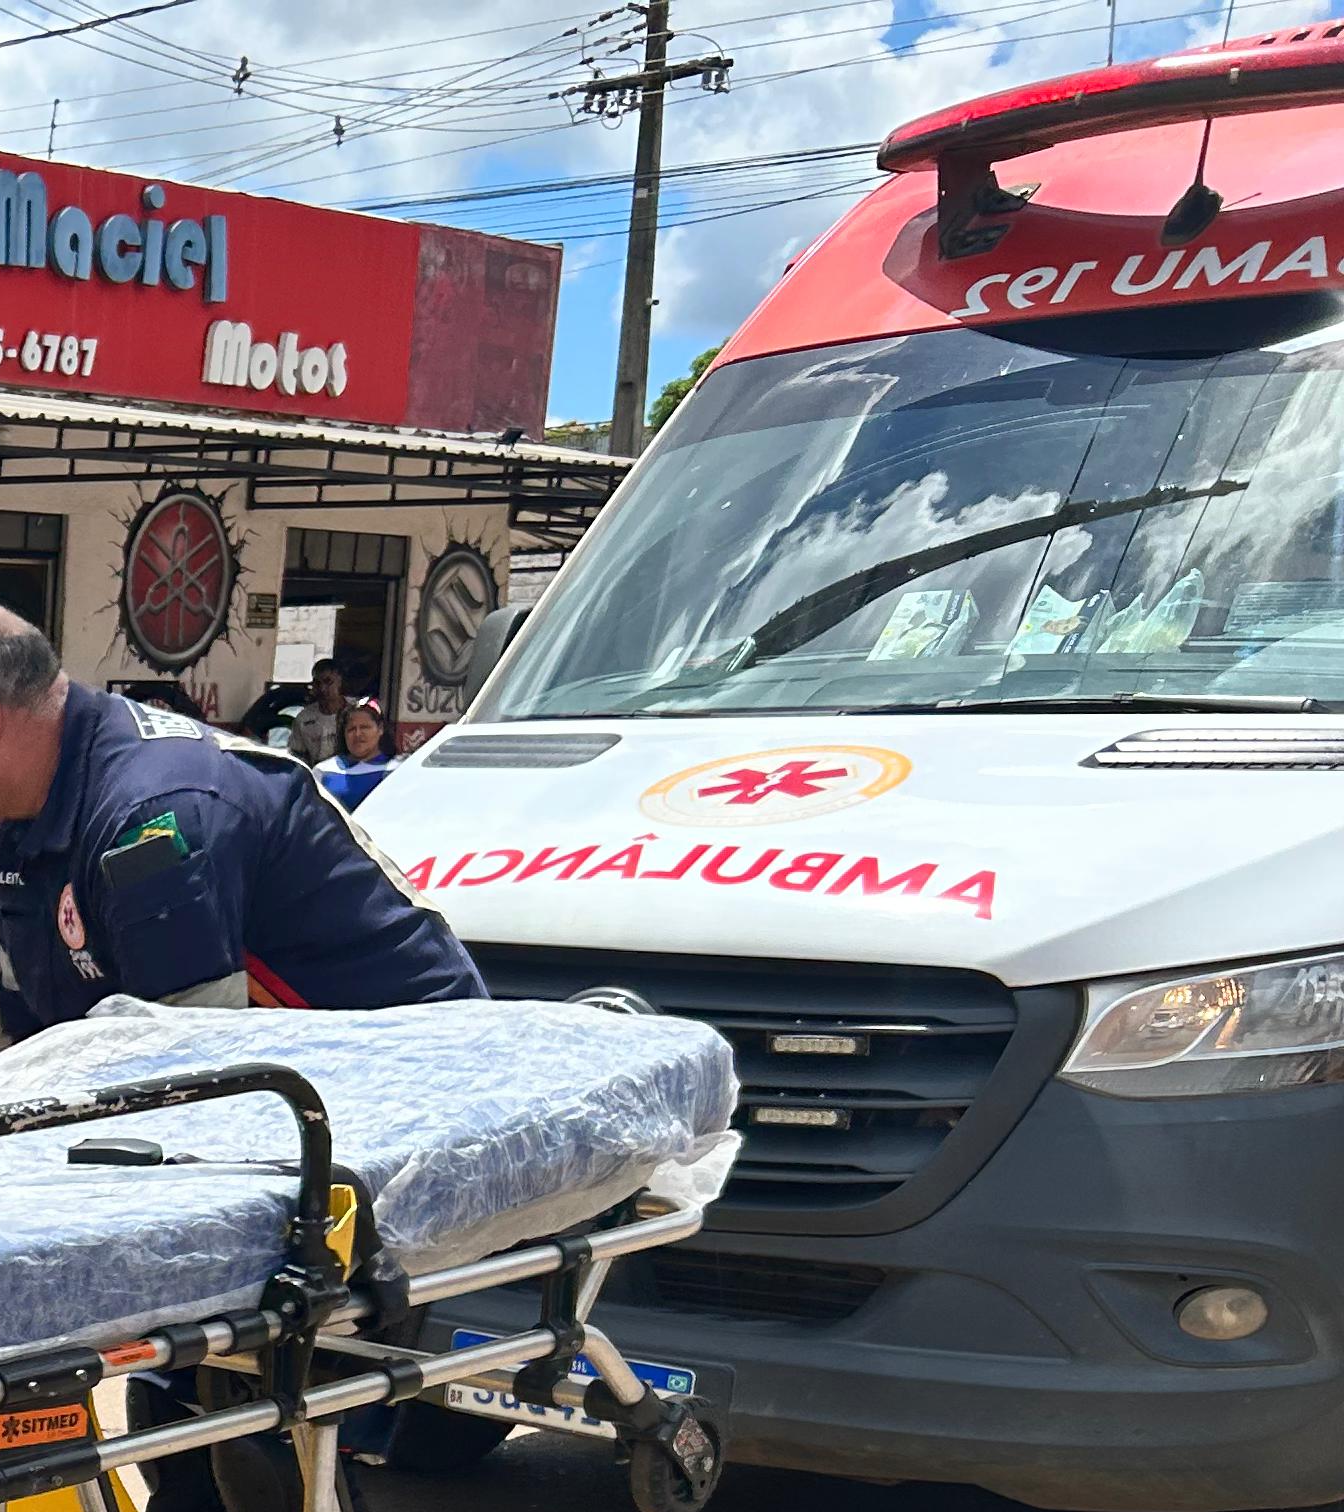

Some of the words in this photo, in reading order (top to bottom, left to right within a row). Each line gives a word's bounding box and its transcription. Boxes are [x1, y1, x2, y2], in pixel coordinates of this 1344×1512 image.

[201, 320, 349, 398] Motos
[407, 685, 470, 714] SUZU
[21, 1412, 80, 1435] SITMED
